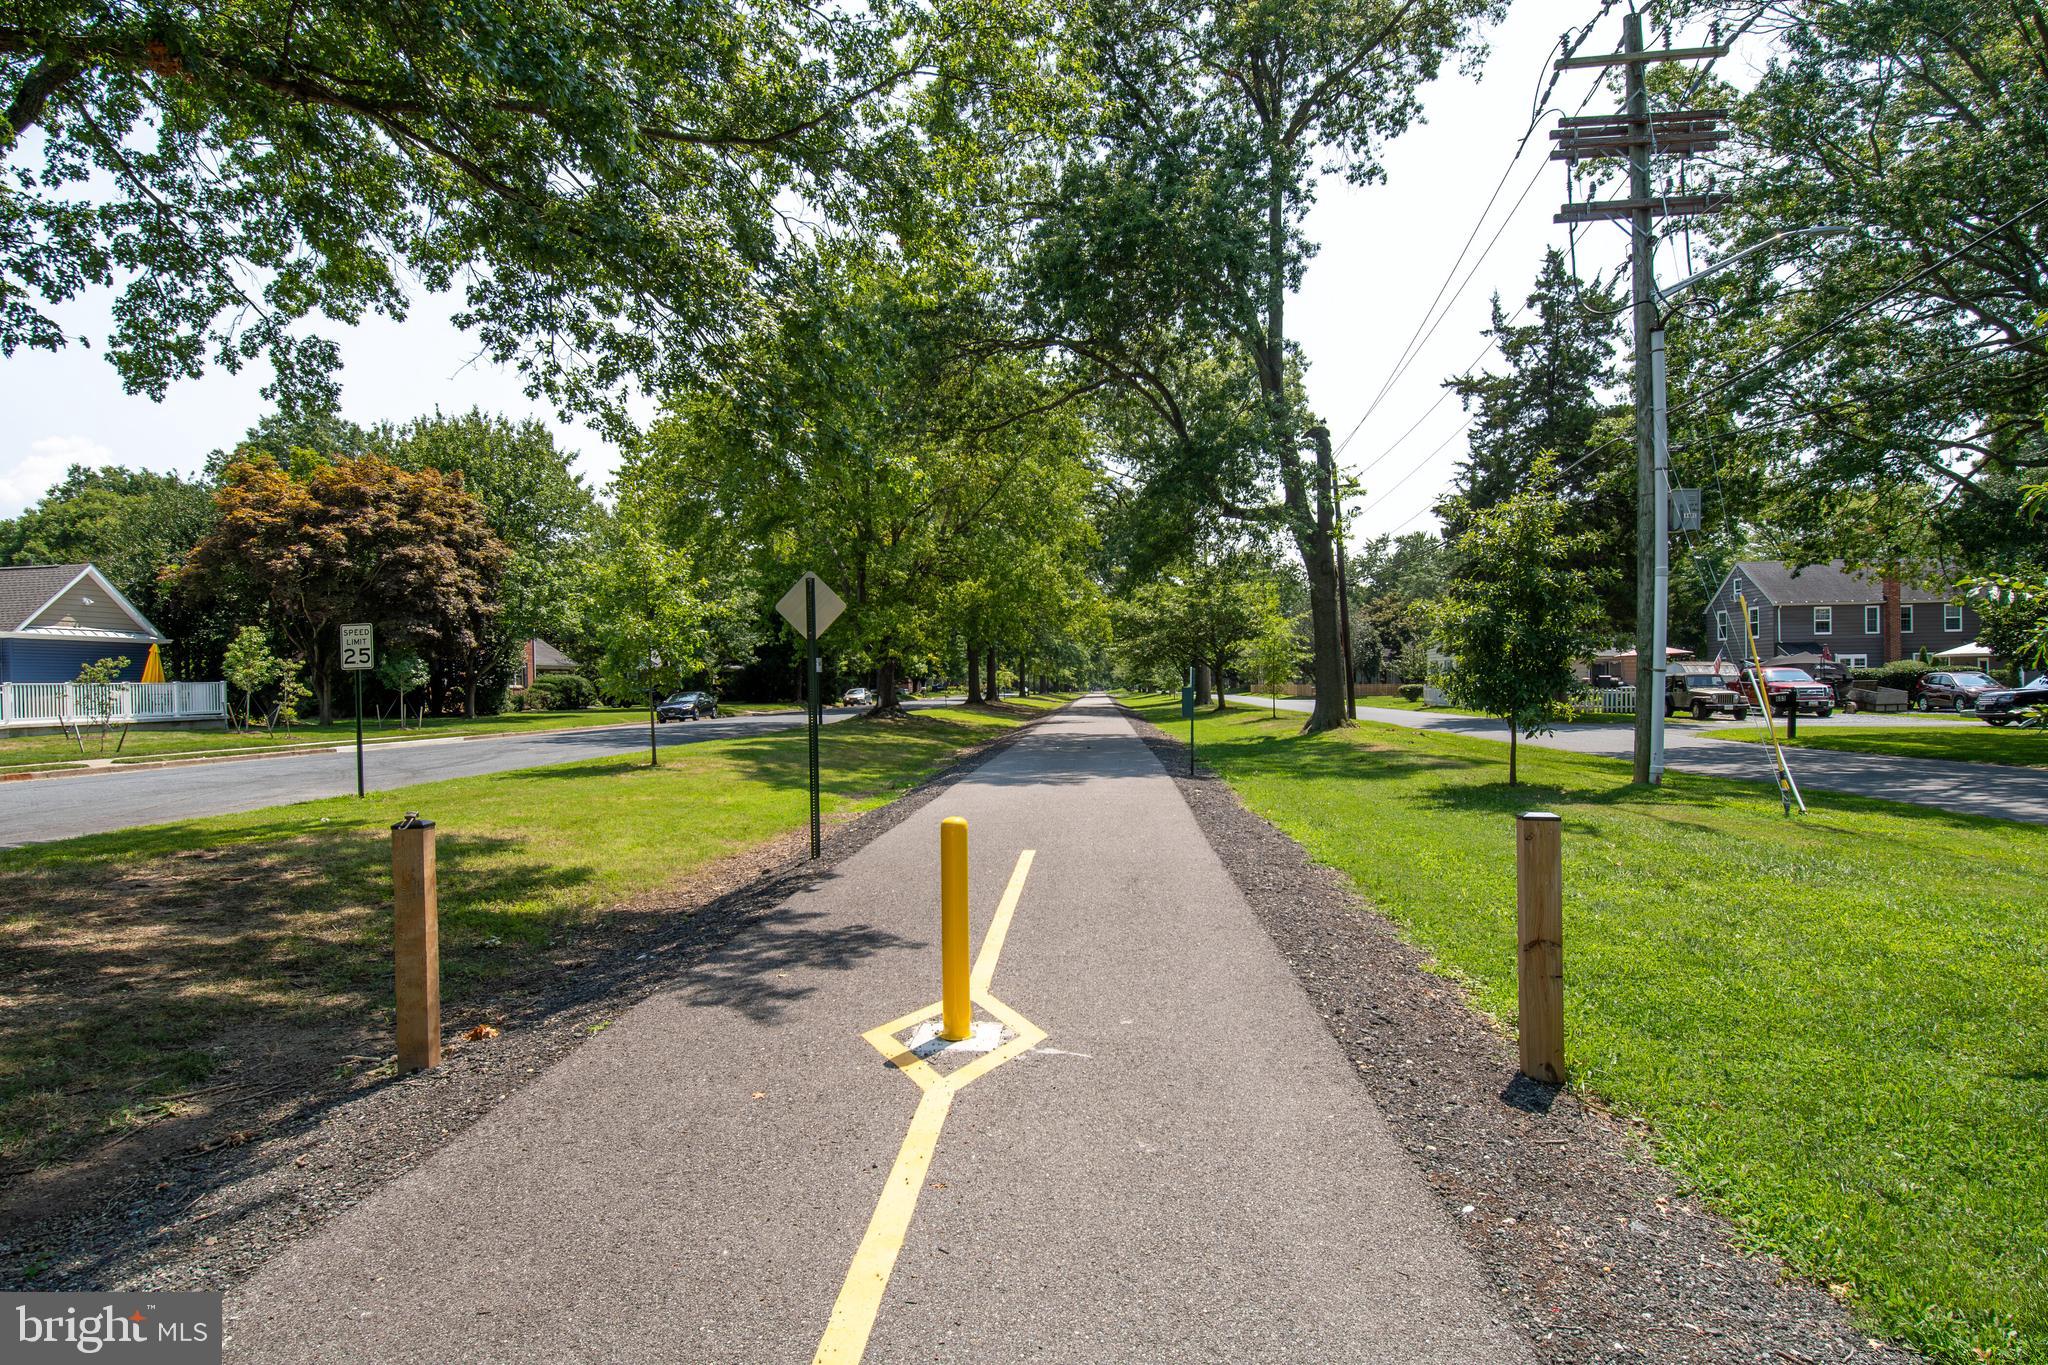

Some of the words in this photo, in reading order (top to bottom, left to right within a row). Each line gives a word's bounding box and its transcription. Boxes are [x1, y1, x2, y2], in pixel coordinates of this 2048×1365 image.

[343, 629, 370, 637] SPEED
[346, 638, 367, 646] LIMIT
[343, 648, 371, 665] 25
